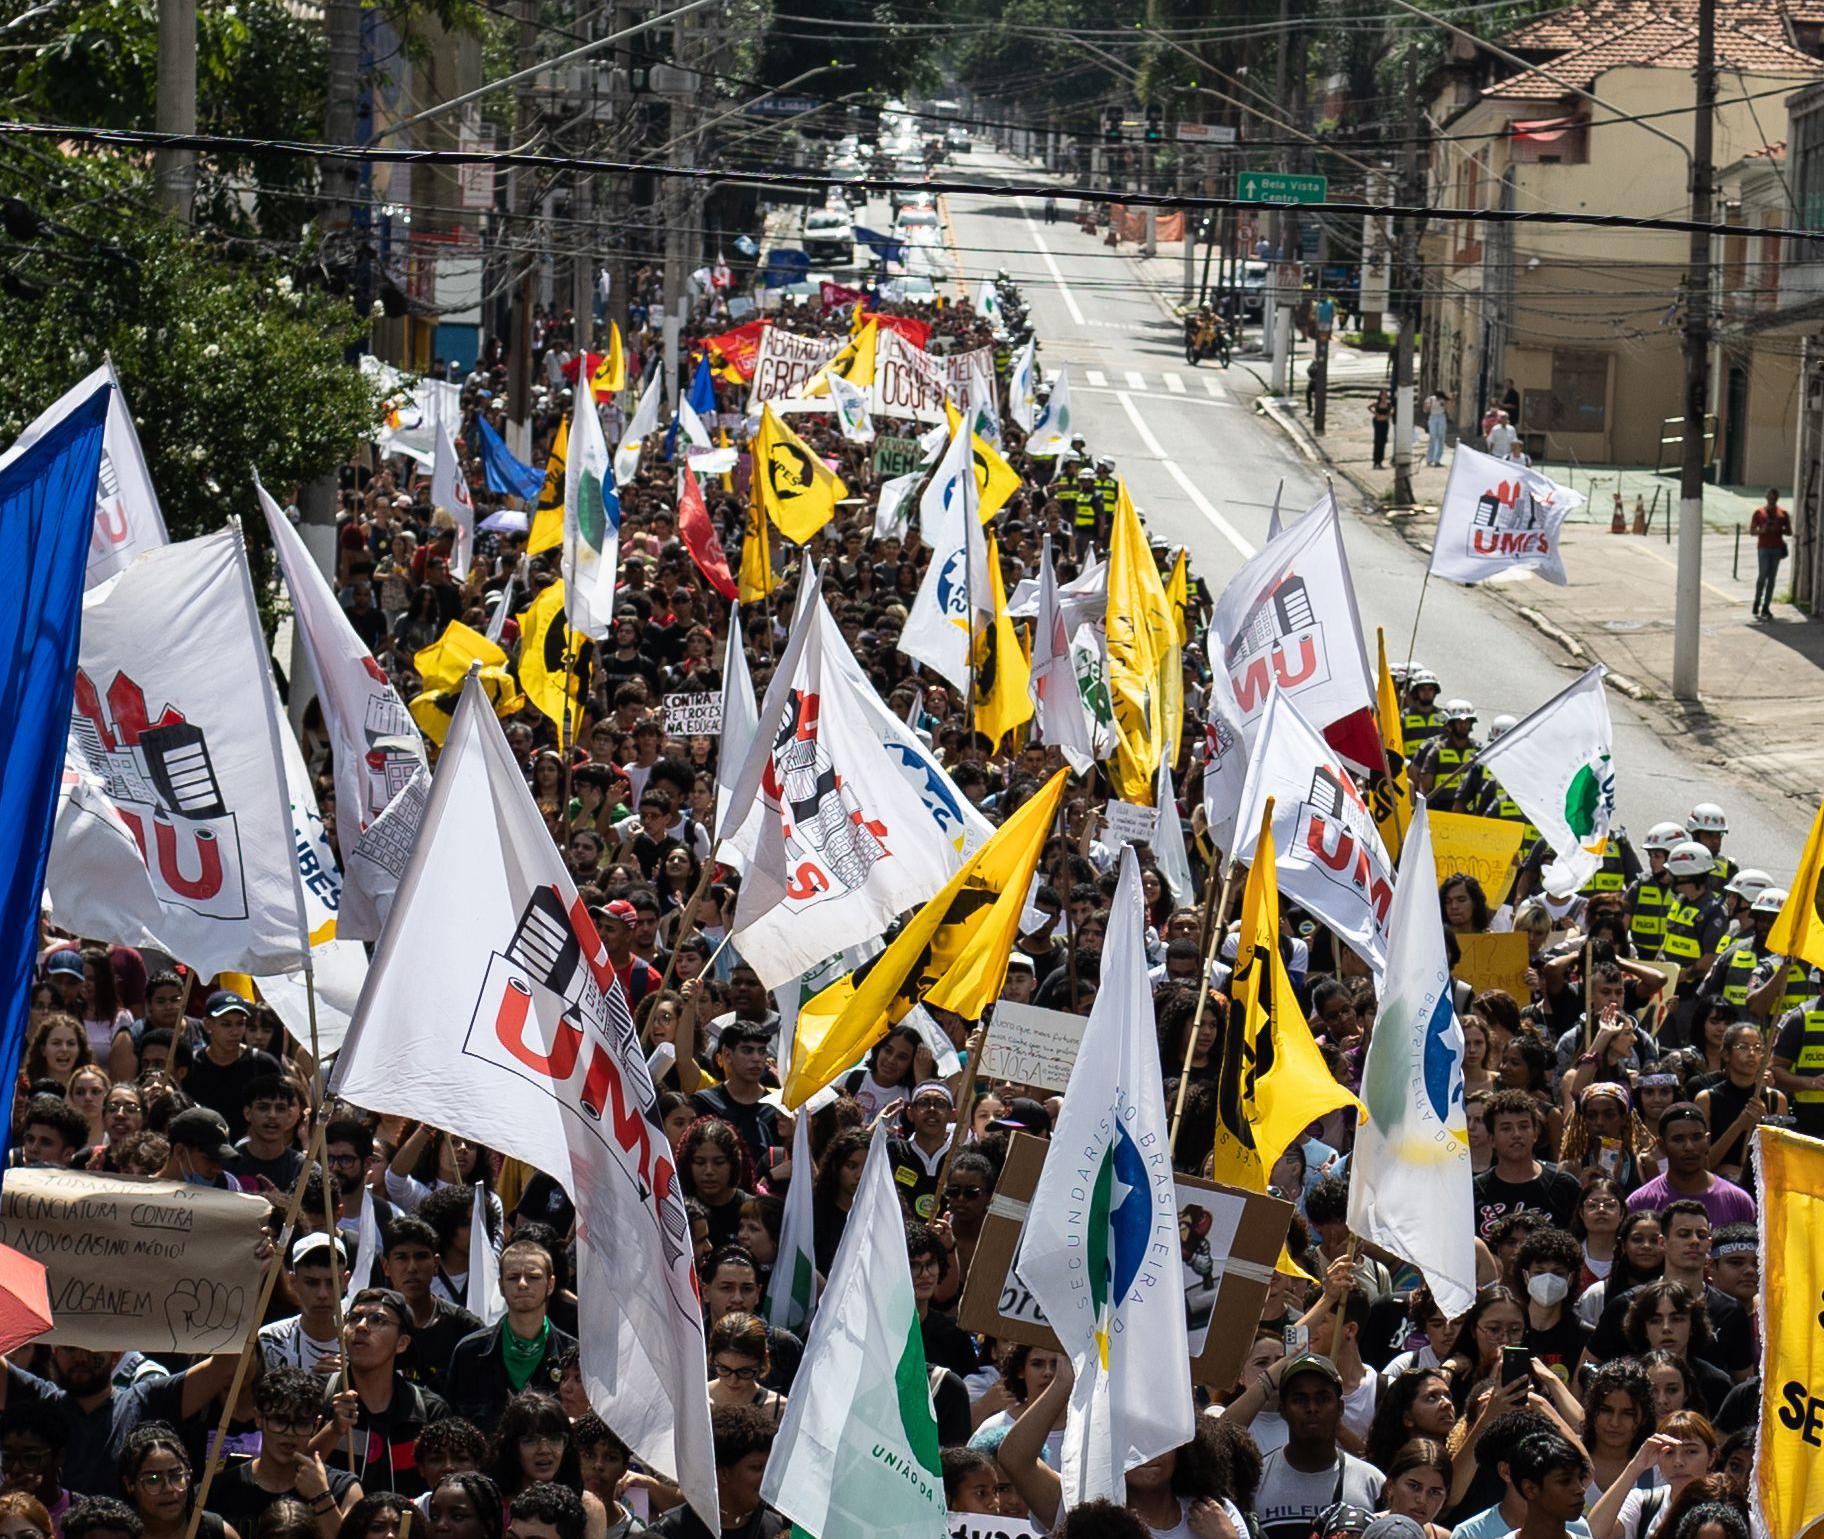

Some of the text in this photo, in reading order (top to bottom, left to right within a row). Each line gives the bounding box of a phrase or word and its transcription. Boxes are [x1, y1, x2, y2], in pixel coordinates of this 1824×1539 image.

[1261, 178, 1320, 192] Bela Vista
[757, 357, 827, 402] GREV
[880, 456, 914, 474] NEM
[1474, 527, 1550, 557] UMES
[664, 692, 712, 708] CONTRA
[667, 721, 683, 733] NA
[0, 1191, 194, 1227] LICENCIATURA CONTRA
[14, 1228, 74, 1252] NOVO
[75, 1232, 127, 1257] ENSINO
[133, 1240, 186, 1260] MÉDIO!
[872, 1444, 934, 1502] UNIÃO DA
